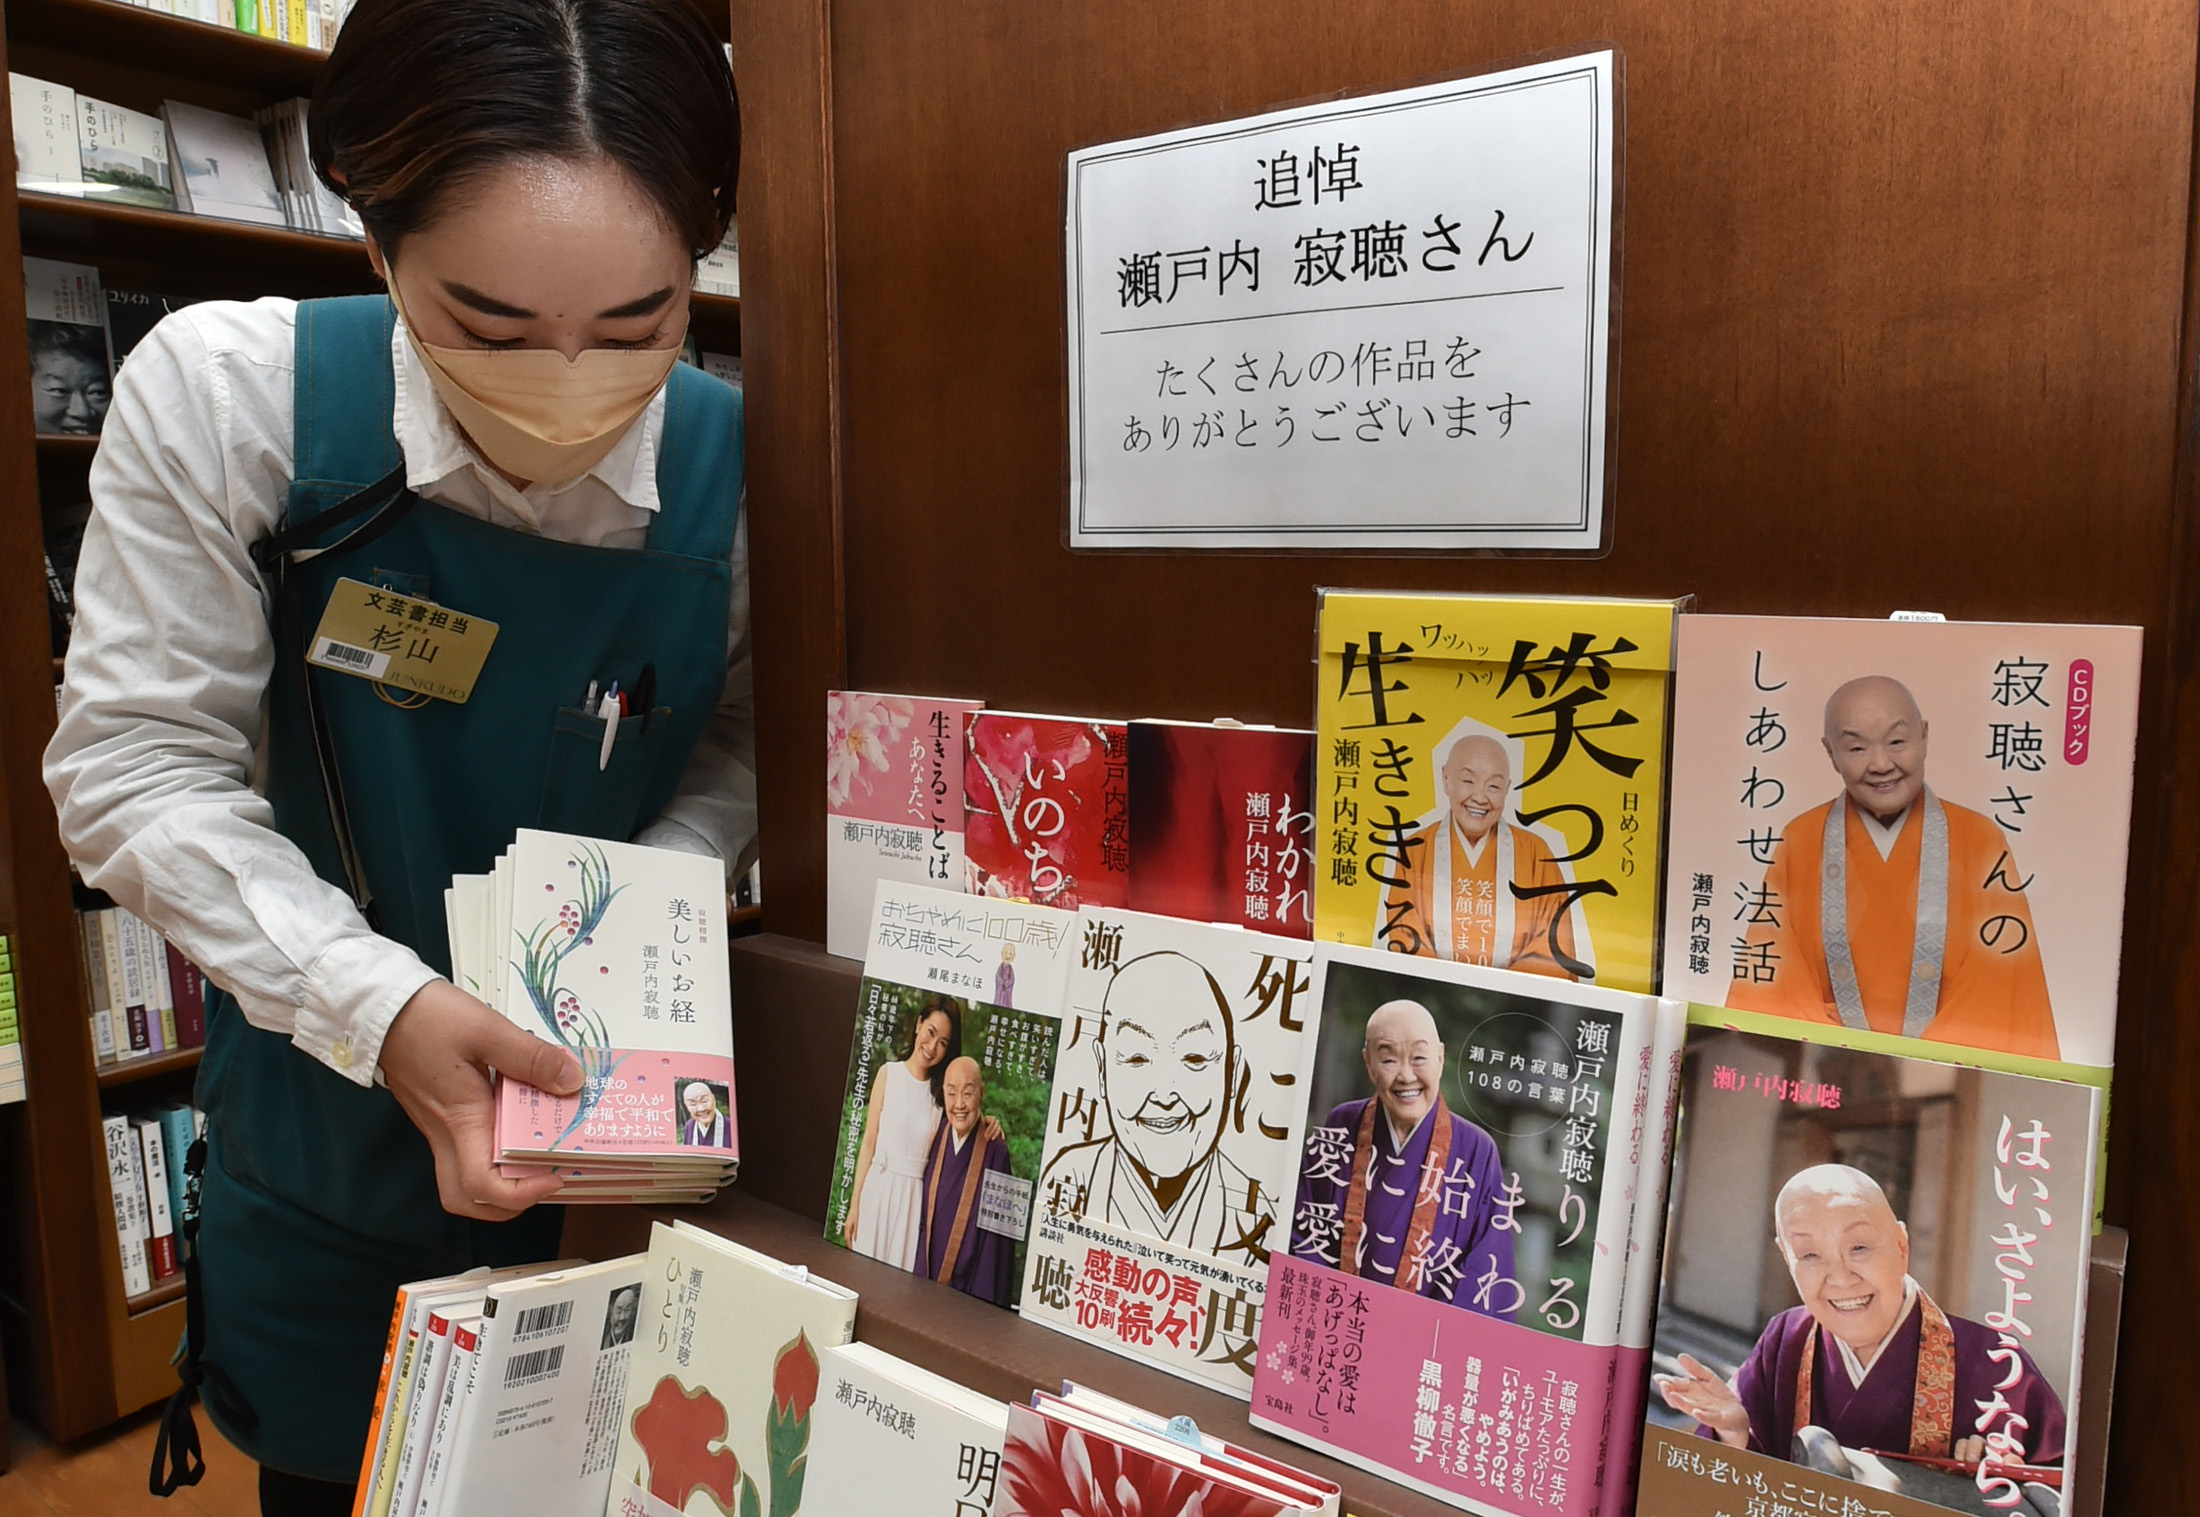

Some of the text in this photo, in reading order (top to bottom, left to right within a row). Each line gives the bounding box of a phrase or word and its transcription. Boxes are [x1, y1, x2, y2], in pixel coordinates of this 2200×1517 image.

[1254, 142, 1364, 212] 追悼
[1117, 209, 1535, 308] 瀬戸内 寂聴さん
[109, 289, 150, 305] ユリイカ
[1156, 336, 1483, 398] たくさんの作品を
[1123, 392, 1532, 453] ありがとうございます
[364, 592, 470, 635] 文芸書担当
[368, 624, 440, 663] 杉山
[397, 620, 429, 635] すぎやま
[389, 671, 466, 700] JUNKUDO
[2068, 668, 2090, 756] CDブック
[906, 736, 926, 822] あなたへ
[928, 710, 951, 881] 生きることば
[1101, 731, 1128, 873] 瀬戸内寂聴
[1330, 738, 1362, 887] 瀬戸内寂聴
[1338, 631, 1426, 956] 生ききる
[1496, 632, 1646, 980] 笑って
[1980, 656, 2051, 955] 寂聴さんの
[843, 820, 924, 852] 瀬戸内寂聴
[1022, 751, 1066, 894] いのち
[1619, 791, 1640, 878] 日めくり
[1730, 650, 1788, 984] しあわせ法話
[1245, 792, 1270, 921] 瀬戸内寂聴
[1275, 793, 1316, 924] わかれ
[877, 922, 983, 965] 寂聴さん
[1688, 872, 1714, 975] 瀬戸内寂聴
[642, 944, 661, 1021] 瀬戸内寂聴
[667, 898, 696, 1024] 美しいお経
[926, 966, 984, 991] 瀬尾まなほ
[984, 1013, 999, 1067] 瀬戸内寂聴
[1005, 1018, 1020, 1077] 食べすぎて、
[1016, 1021, 1031, 1079] お腹がすき、
[1027, 1024, 1042, 1082] 笑いすぎて、
[1037, 1025, 1054, 1084] 読んだ人は、
[1469, 1044, 1570, 1081] 瀬戸内寂聴
[583, 1091, 665, 1107] すべての人が
[583, 1105, 675, 1123] 幸福で平和で
[584, 1075, 627, 1091] 地球の
[835, 984, 883, 1236] 「日々若返る」先生の秘密を明かします
[1030, 918, 1126, 1312] 瀬戸内寂聴
[1466, 1069, 1567, 1105] 108の言葉
[1557, 1020, 1611, 1183] 瀬戸内寂聴
[1712, 1064, 1843, 1111] 瀬戸内寂聴
[106, 1124, 131, 1185] 谷沢永一
[583, 1122, 667, 1138] ありますように
[981, 1207, 1025, 1228] 特別書き下ろし
[982, 1191, 1027, 1216] 「まなほへ」
[984, 1180, 1029, 1200] 先生からの手紙
[1306, 1125, 1588, 1248] 愛に始まり
[1039, 1228, 1065, 1246] 講談社
[1041, 1213, 1267, 1294] 「人生に勇気を与えられた」「泣いて笑って元気が湧いてくる
[1291, 1200, 1581, 1331] 愛に終わる
[658, 1256, 682, 1353] ひとり
[676, 1266, 704, 1368] 瀬戸内寂聴
[1074, 1279, 1120, 1309] 大反響
[1074, 1300, 1116, 1330] 10刷
[1276, 1266, 1297, 1320] 最新刊
[1287, 1271, 1309, 1370] 珠玉のメッセージ集
[1973, 1113, 2053, 1517] はい、さようなら
[465, 1322, 489, 1396] 生きてこそ
[512, 1325, 570, 1343] 9784106107207
[1308, 1276, 1348, 1434] 「あげっぱなし」。
[1337, 1290, 1371, 1416] 本当の愛は
[436, 1354, 462, 1445] 美は乱調にあり
[503, 1370, 561, 1390] 1920210007400
[835, 1378, 917, 1441] 瀬戸内寂聴
[1265, 1394, 1294, 1415] 宝島社
[1436, 1404, 1456, 1475] 名言です。
[1452, 1356, 1482, 1479] 器量が悪くなる」
[1473, 1413, 1494, 1488] やめよう。
[1490, 1366, 1521, 1494] 「いがみあうのは、
[1510, 1383, 1536, 1501] ちりばめてある。
[1528, 1369, 1559, 1507] ユーモアたっぷりに、
[1548, 1379, 1579, 1513] 寂聴さんの一生が、
